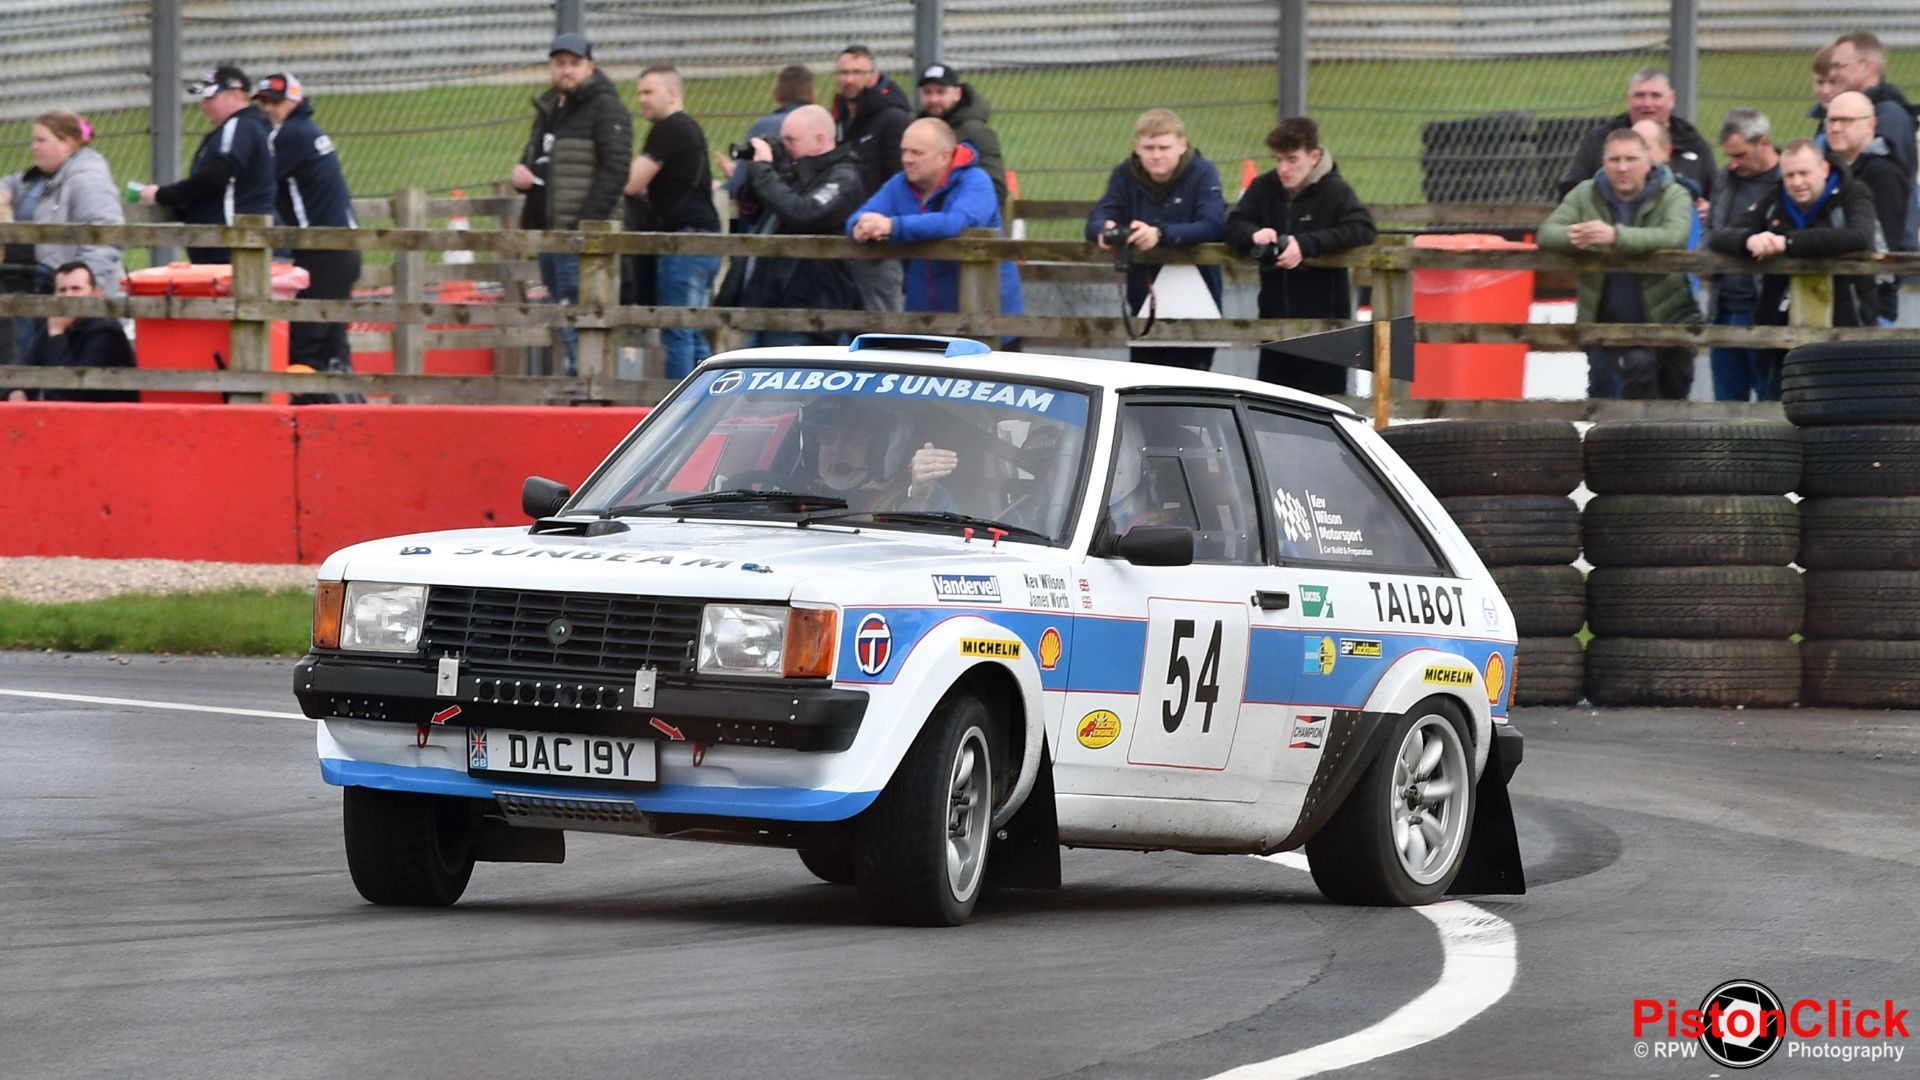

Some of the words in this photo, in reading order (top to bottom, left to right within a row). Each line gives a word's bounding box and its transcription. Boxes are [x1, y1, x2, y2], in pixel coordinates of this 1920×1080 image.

[747, 371, 875, 392] TALBOT
[876, 374, 1056, 412] SUNBEAM
[1310, 494, 1326, 508] Kev
[1314, 510, 1342, 525] Wilson
[1318, 526, 1363, 544] Motorsport
[453, 546, 735, 569] SUNBEAM
[932, 576, 1001, 596] Vandervell
[1023, 573, 1038, 589] Kev
[1039, 573, 1066, 590] Wilson
[1029, 592, 1049, 608] James
[1050, 592, 1070, 608] Worth
[1368, 582, 1466, 627] TALBOT
[962, 641, 1020, 656] MICHELIN
[1162, 619, 1223, 733] 54
[1424, 668, 1474, 684] MICHELIN
[1293, 726, 1324, 738] CHAMPION
[472, 757, 487, 768] GB
[508, 734, 573, 771] DAC
[584, 739, 636, 776] 19Y
